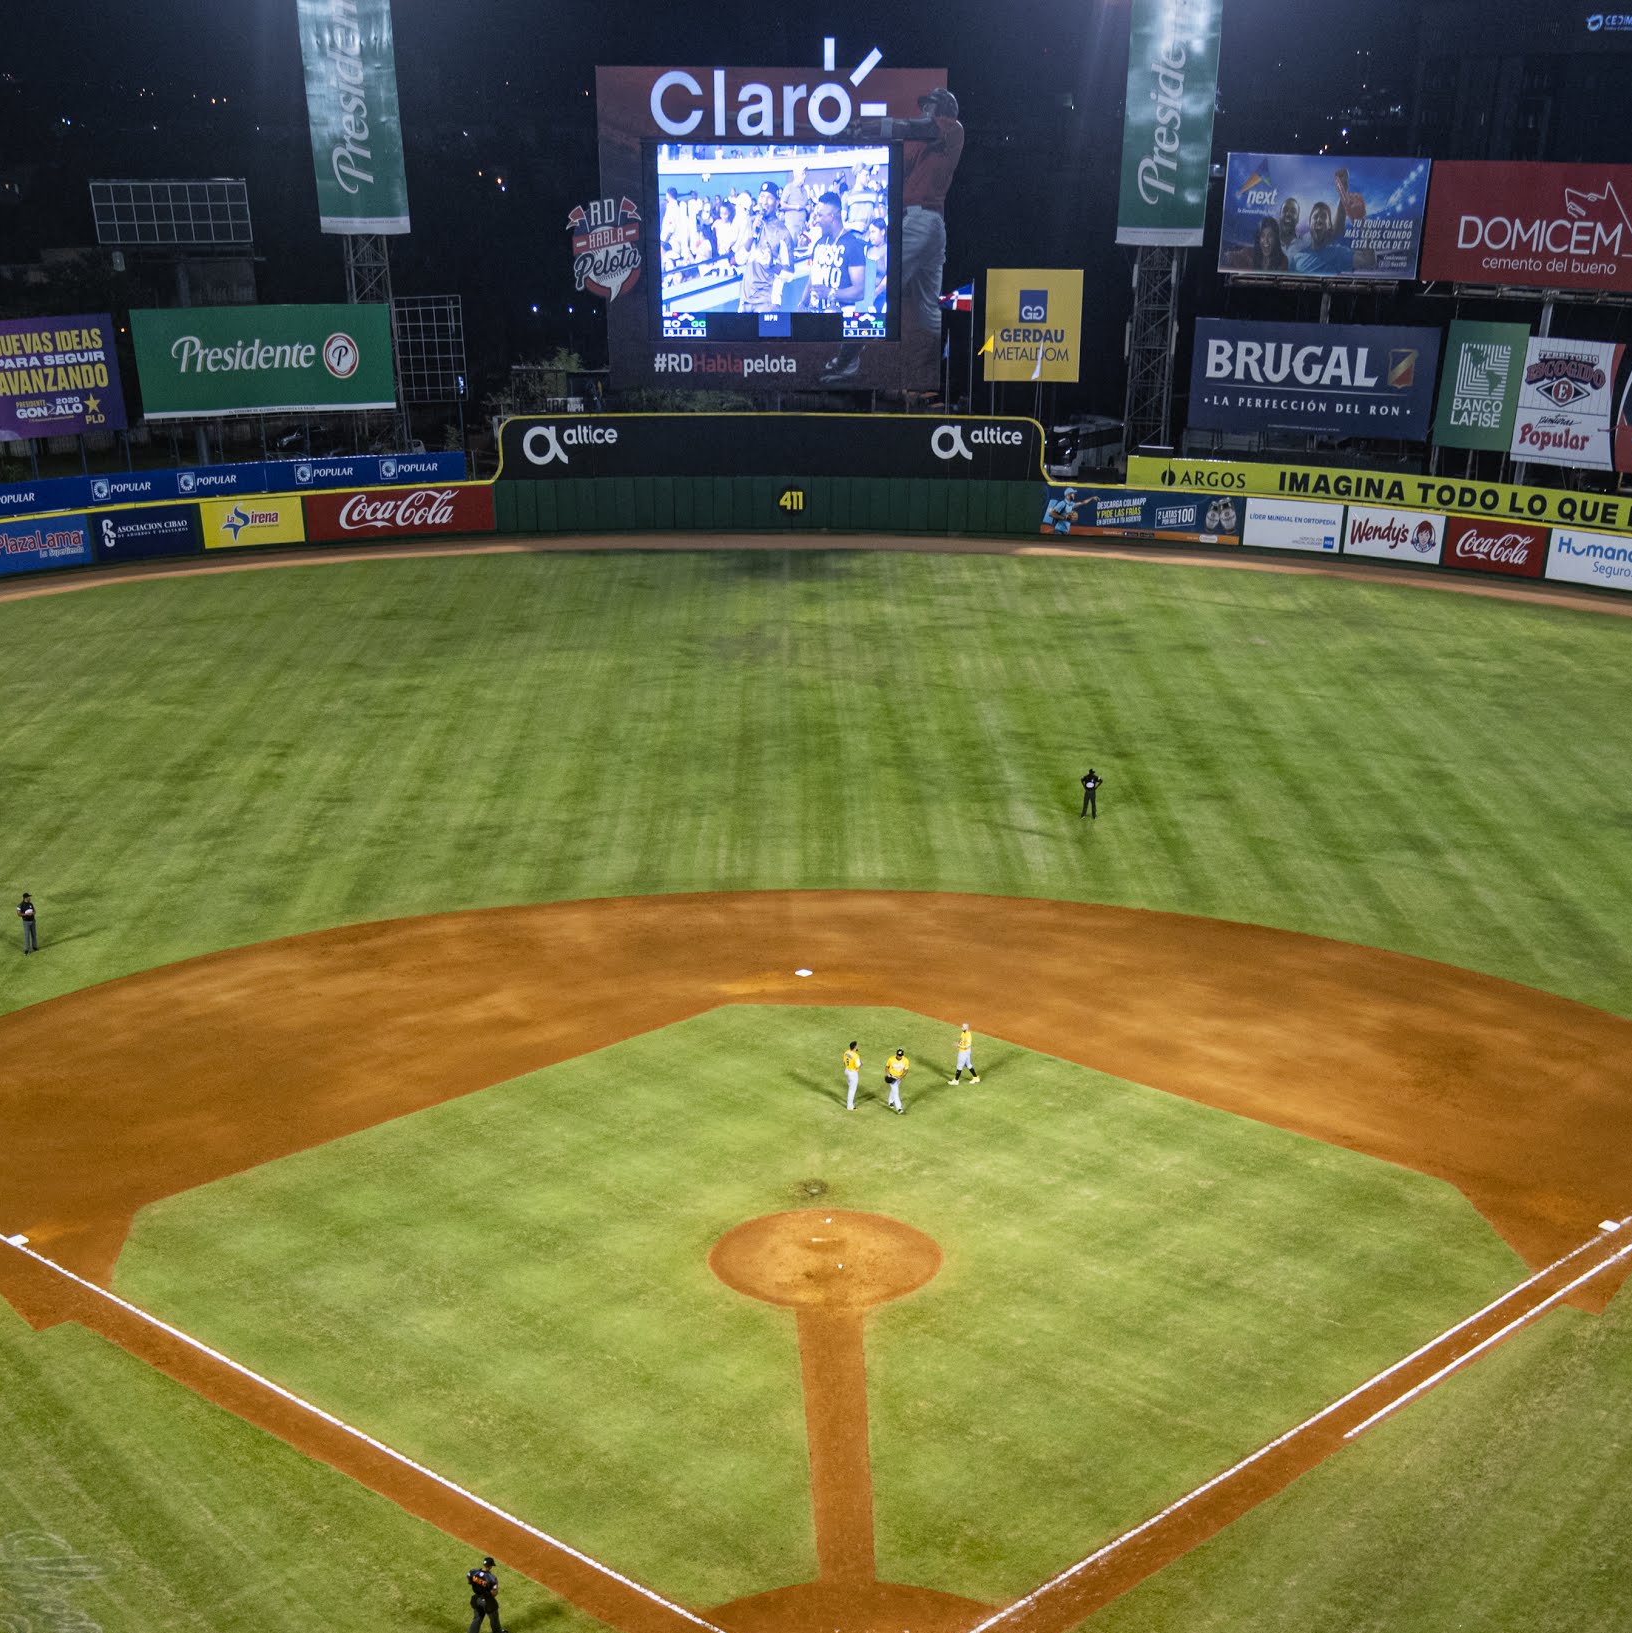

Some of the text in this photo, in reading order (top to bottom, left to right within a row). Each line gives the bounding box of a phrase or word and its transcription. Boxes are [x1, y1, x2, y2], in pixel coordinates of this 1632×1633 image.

[649, 68, 853, 137] Claro
[1246, 188, 1278, 206] next
[590, 199, 615, 228] RD
[1382, 230, 1412, 240] CUANDO
[1389, 220, 1413, 230] LLEGA
[1456, 214, 1624, 256] DOMICEM
[588, 228, 625, 250] HABLA
[574, 246, 641, 289] Pelota
[1481, 256, 1617, 276] cemento del bueno
[56, 328, 103, 351] IDEAS
[999, 328, 1065, 343] GERDAU
[43, 351, 106, 366] SEGUIR
[171, 335, 316, 374] Presidente
[992, 346, 1070, 363] METALDOM
[1205, 339, 1379, 388] BRUGAL
[1538, 351, 1600, 365] TERRITORIO
[653, 354, 798, 378] #RDHablapelota
[1525, 362, 1607, 390] ESCOGIDO
[1213, 395, 1401, 417] LA PERFECCIÓN DEL RON
[1452, 398, 1504, 414] BANCO
[85, 414, 106, 425] PLD
[1449, 411, 1501, 428] LAFISE
[562, 424, 618, 445] altice
[970, 425, 1023, 446] altice
[1518, 423, 1590, 451] Popular
[313, 466, 354, 478] POPULAR
[398, 462, 438, 473] POPULAR
[110, 481, 151, 493] POPULAR
[196, 474, 237, 486] POPULAR
[1179, 470, 1247, 488] ARGOS
[778, 490, 805, 511] 411
[1278, 471, 1406, 502] IMAGINA
[1417, 482, 1500, 511] TODO
[1509, 492, 1548, 517] LO
[1557, 496, 1620, 526] QUE
[339, 488, 460, 531] Coca-Cola
[1177, 508, 1194, 523] 100
[164, 519, 188, 529] CIBAO
[1350, 517, 1409, 550] Wendy's
[1455, 528, 1536, 566] Coca-Cola
